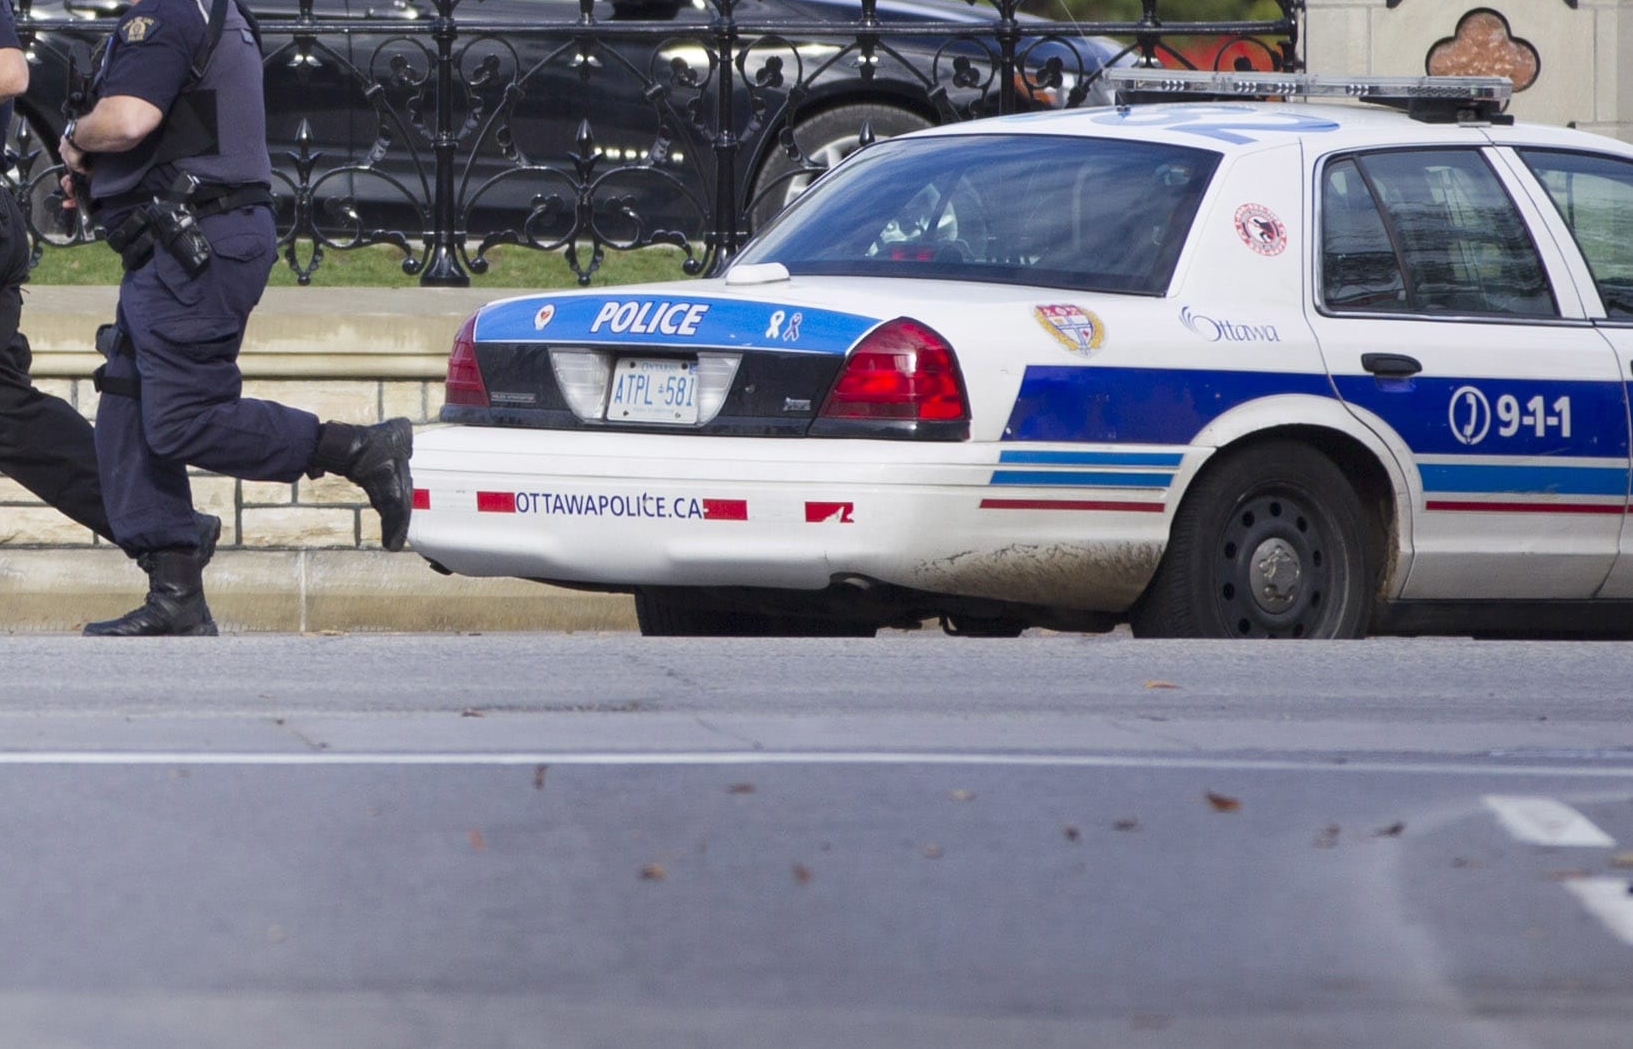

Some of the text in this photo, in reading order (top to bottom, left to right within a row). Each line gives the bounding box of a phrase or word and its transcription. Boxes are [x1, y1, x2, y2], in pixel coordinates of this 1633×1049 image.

[589, 301, 711, 336] POLICE
[1179, 306, 1281, 342] Ottawa
[1497, 394, 1571, 438] 9-1-1
[516, 491, 703, 519] OTTAWAPOLICE.CA
